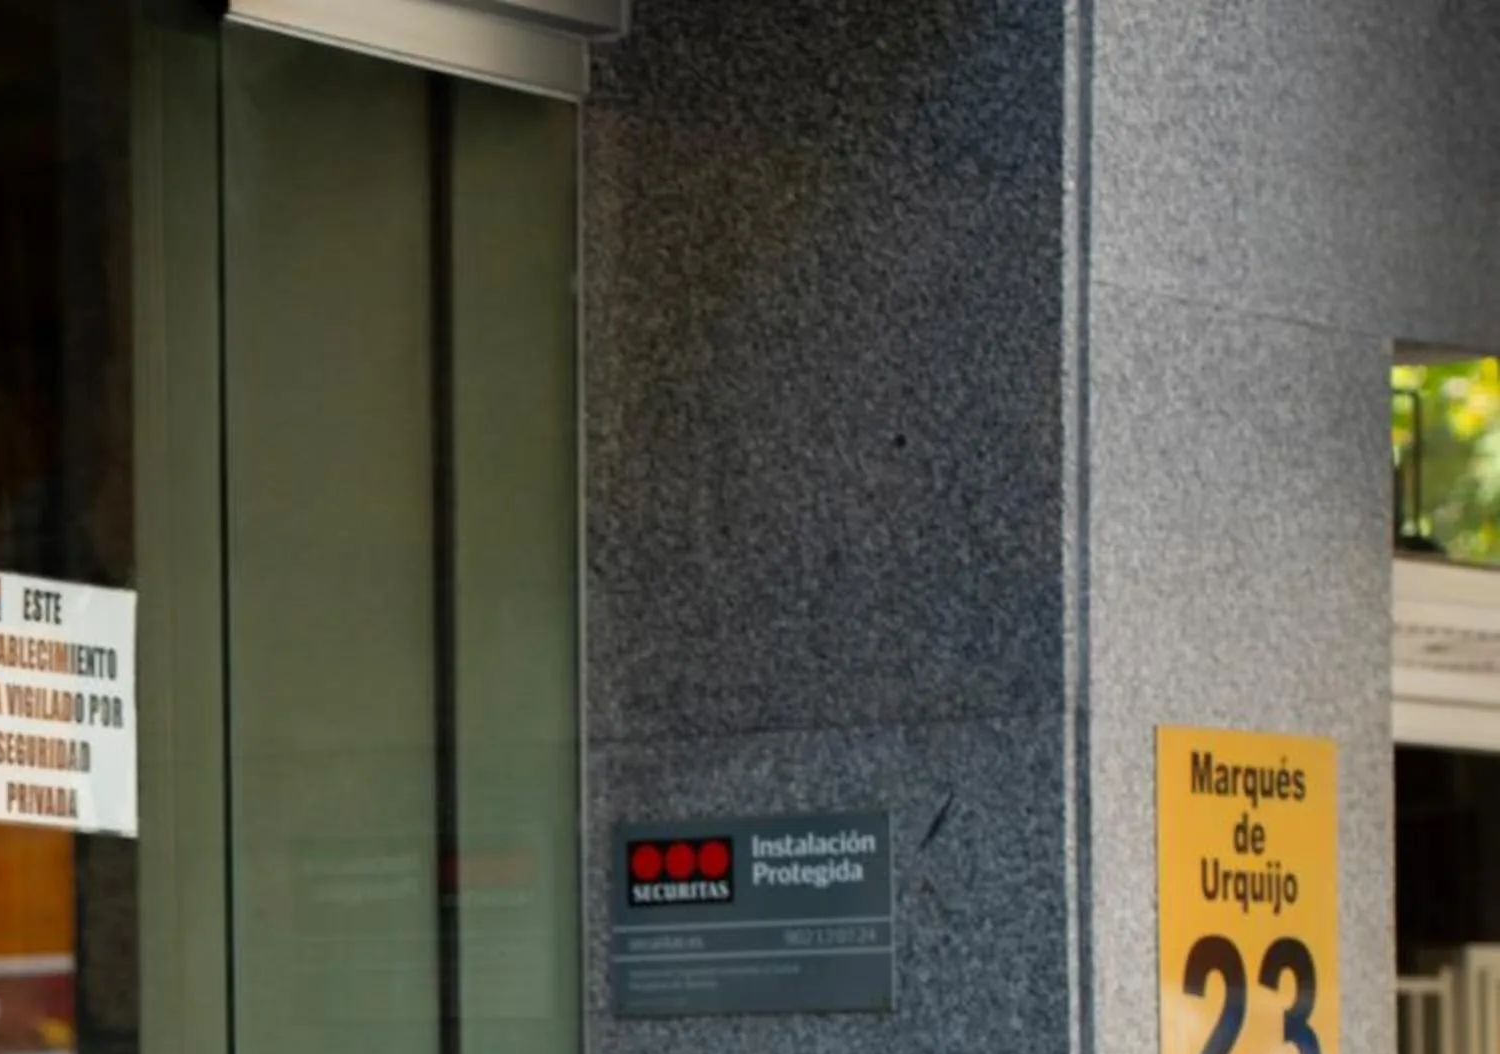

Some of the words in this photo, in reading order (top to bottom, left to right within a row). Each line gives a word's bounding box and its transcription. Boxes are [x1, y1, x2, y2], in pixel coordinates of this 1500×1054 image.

[23, 587, 62, 625] ESTE
[6, 682, 83, 724] VIGILADO
[88, 695, 123, 728] POR
[1190, 752, 1306, 808] Marqués
[6, 781, 78, 818] PRIVADA
[752, 829, 876, 858] Instalación
[1233, 813, 1266, 854] de
[631, 880, 730, 903] SECURITAS
[752, 860, 864, 888] Protegida
[1201, 858, 1298, 914] Urquijo
